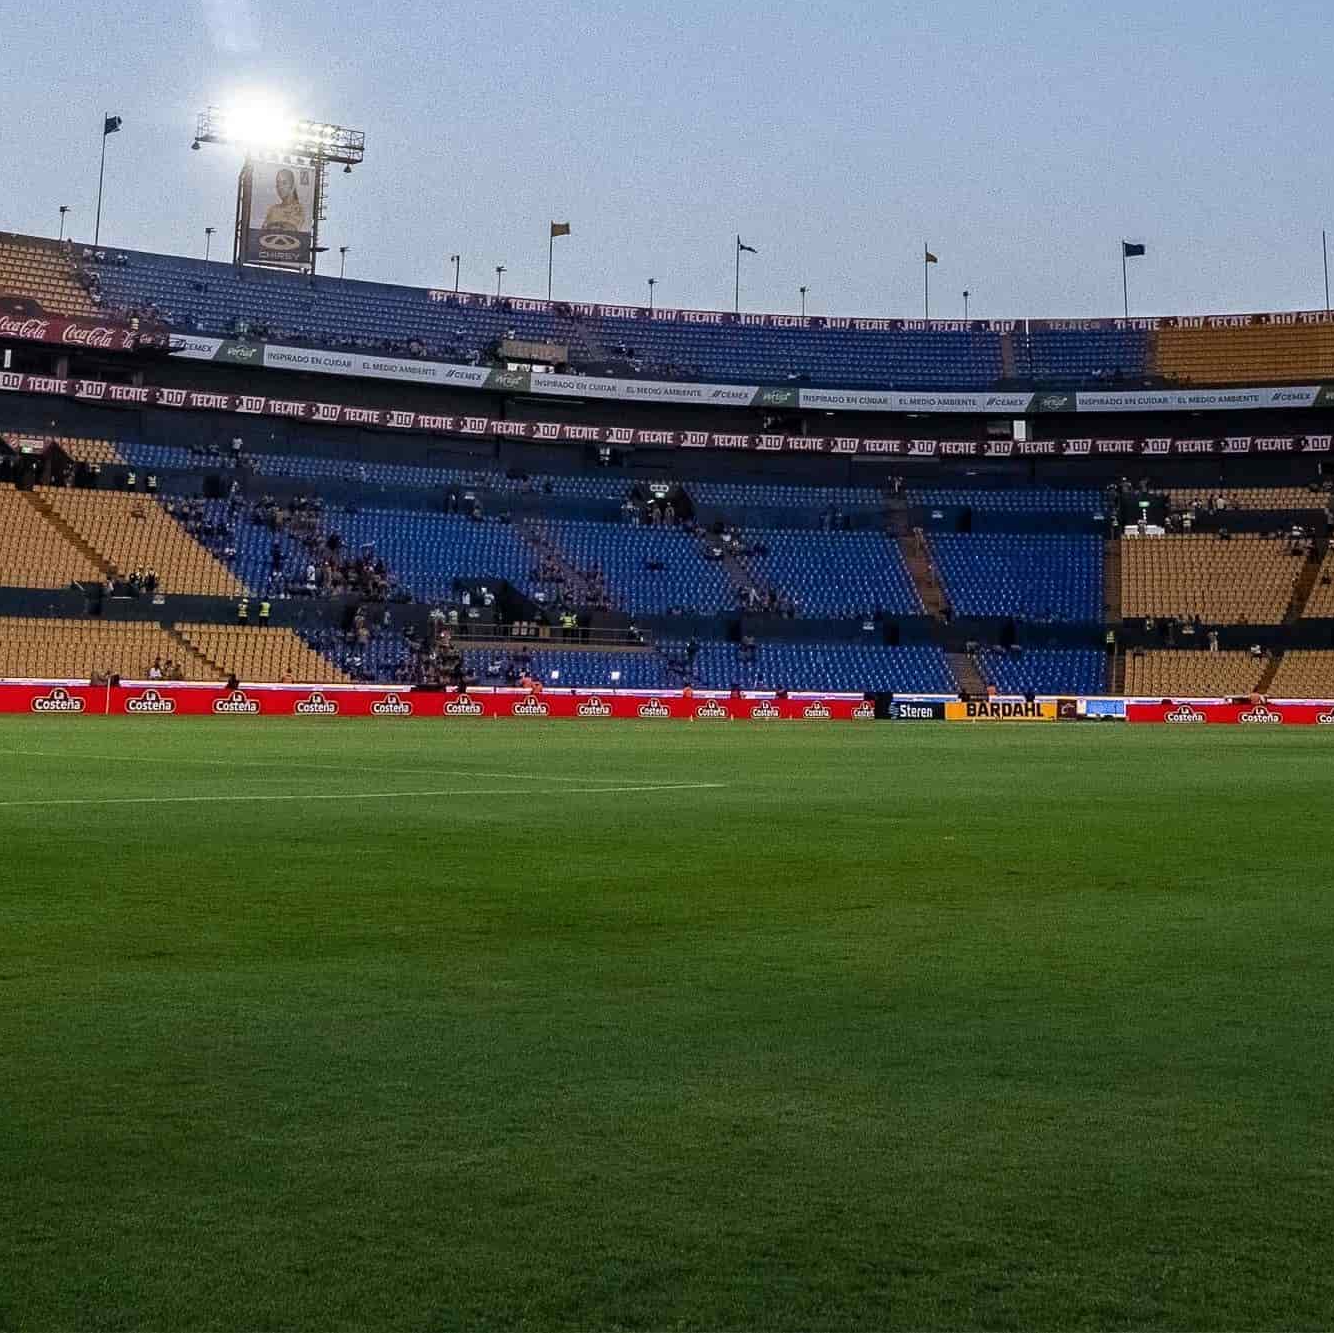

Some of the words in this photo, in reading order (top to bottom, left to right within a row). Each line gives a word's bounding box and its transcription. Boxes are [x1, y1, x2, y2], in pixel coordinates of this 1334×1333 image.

[27, 376, 67, 394] TECATE
[109, 385, 148, 402] TECATE
[190, 393, 228, 409] TECATE
[268, 400, 305, 415] TECATE
[344, 407, 379, 423] TECATE
[418, 415, 454, 429] TECATE
[491, 421, 526, 435] TECATE
[563, 425, 599, 439] TECATE
[638, 430, 674, 444] TECATE
[712, 435, 748, 448] TECATE
[787, 438, 824, 451] TECATE
[863, 439, 901, 452] TECATE
[939, 441, 977, 454] TECATE
[1017, 441, 1055, 454] TECATE
[1096, 440, 1134, 453] TECATE
[1175, 439, 1214, 452] TECATE
[1254, 438, 1293, 451] TECATE
[35, 697, 80, 710] Costeña
[129, 698, 171, 711] Costeña
[216, 700, 256, 712] Costeña
[966, 702, 1044, 717] BARDAHL
[899, 704, 933, 718] Steren
